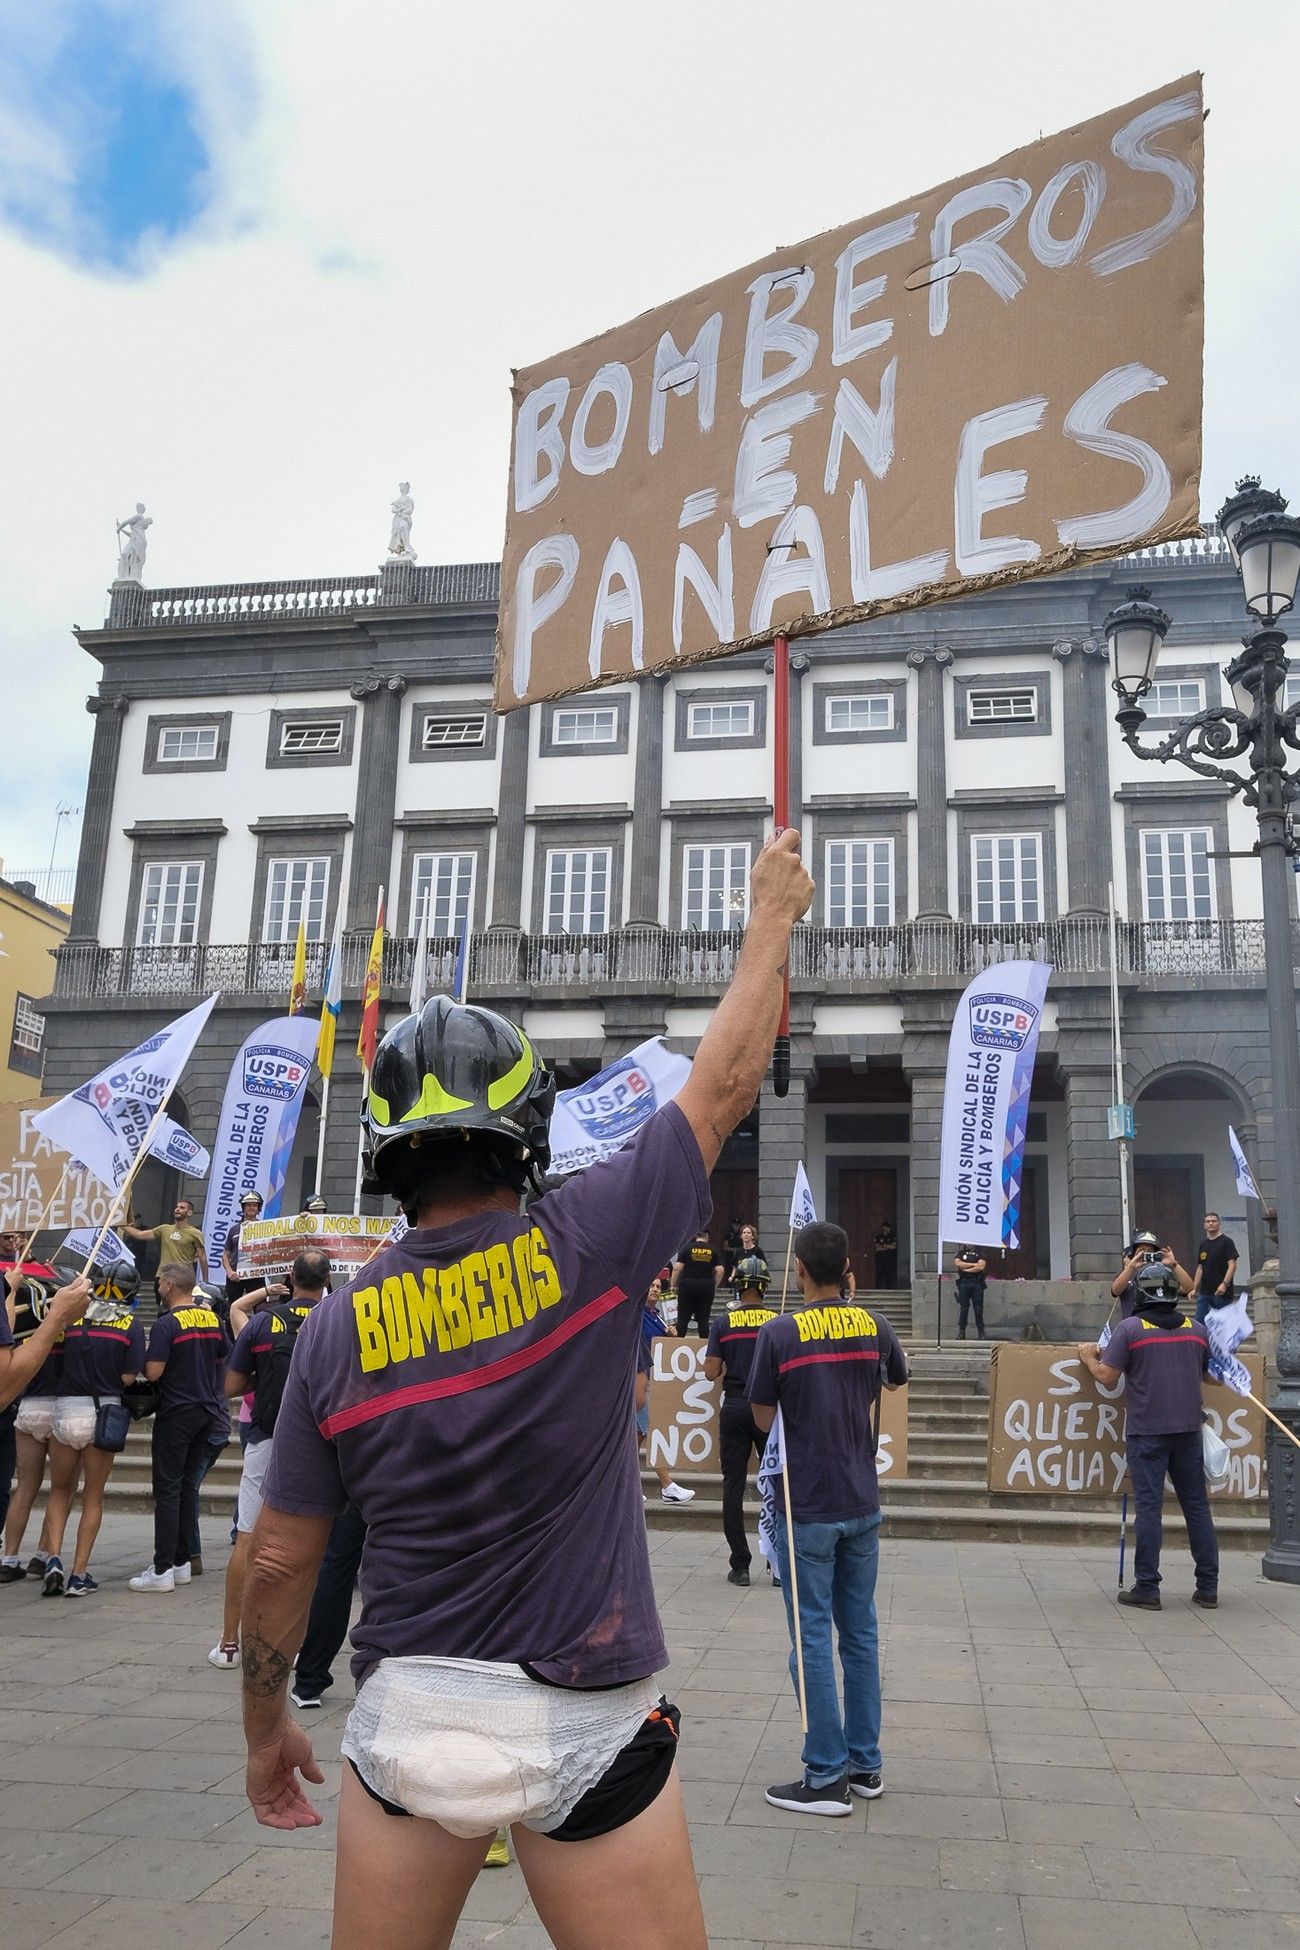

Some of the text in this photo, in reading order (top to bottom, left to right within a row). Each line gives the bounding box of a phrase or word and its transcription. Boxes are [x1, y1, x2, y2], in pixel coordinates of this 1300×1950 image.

[515, 90, 1200, 512] BOMBEROS
[733, 355, 898, 528] EN
[512, 361, 1174, 699] PAÑALES
[976, 1008, 1028, 1030] USPB
[976, 1034, 1018, 1048] CANARIAS
[249, 1058, 301, 1081] USPB
[248, 1084, 290, 1098] CANARIAS
[576, 1071, 647, 1115] USPB
[234, 1102, 251, 1121] LA
[172, 1135, 196, 1154] USPB
[229, 1124, 246, 1143] DE
[241, 1104, 270, 1189] BOMBEROS
[956, 1051, 982, 1223] UNIÓN SINDICAL DE LA
[975, 1053, 1002, 1225] POLICÍA Y BOMBEROS
[217, 1150, 242, 1217] SINDICAL
[0, 1198, 126, 1233] MBEROS
[323, 1216, 361, 1234] NOS
[208, 1220, 229, 1269] UNIÓN
[352, 1225, 562, 1373] BOMBEROS
[792, 1307, 877, 1343] BOMBEROS
